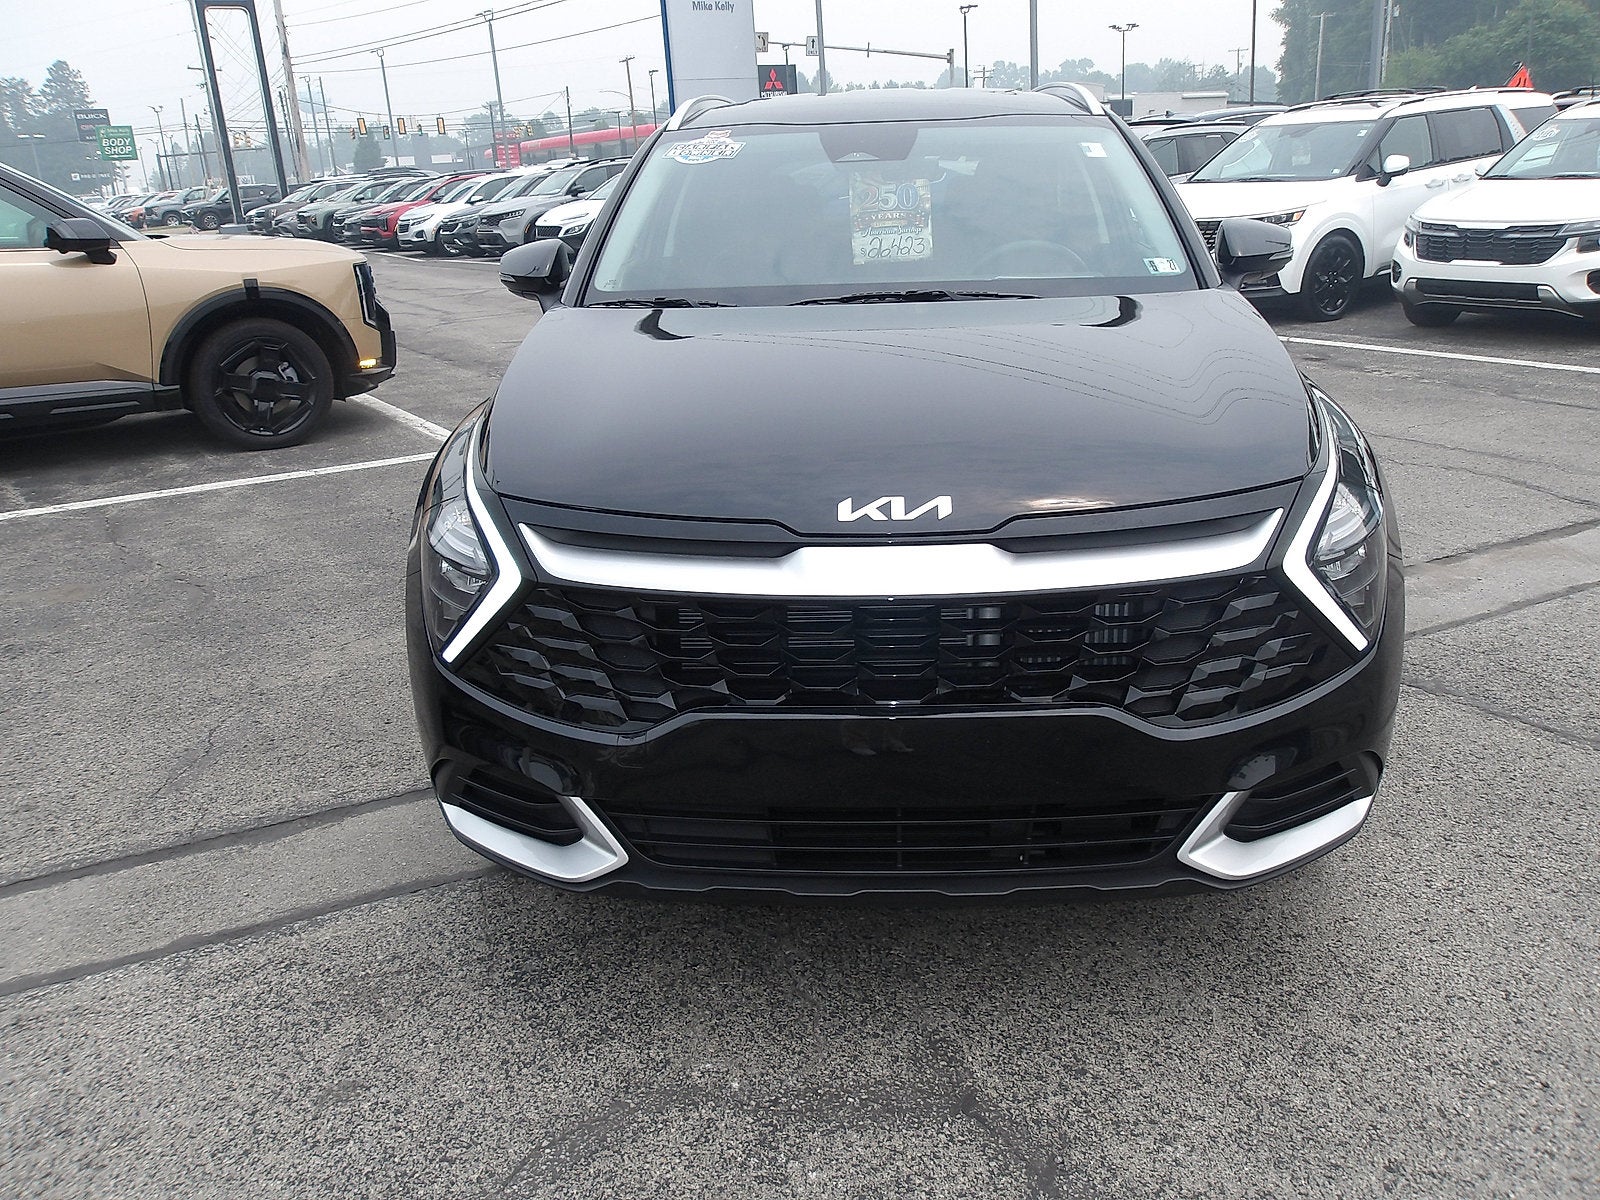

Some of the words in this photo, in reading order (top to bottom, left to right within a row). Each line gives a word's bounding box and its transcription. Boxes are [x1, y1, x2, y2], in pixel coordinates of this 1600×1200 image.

[692, 1, 713, 11] Mike
[715, 2, 735, 13] Kelly
[76, 112, 107, 120] BUICK
[102, 138, 131, 147] BODY
[105, 146, 133, 155] SHOP
[860, 183, 920, 212] 250
[837, 496, 953, 522] KIA
